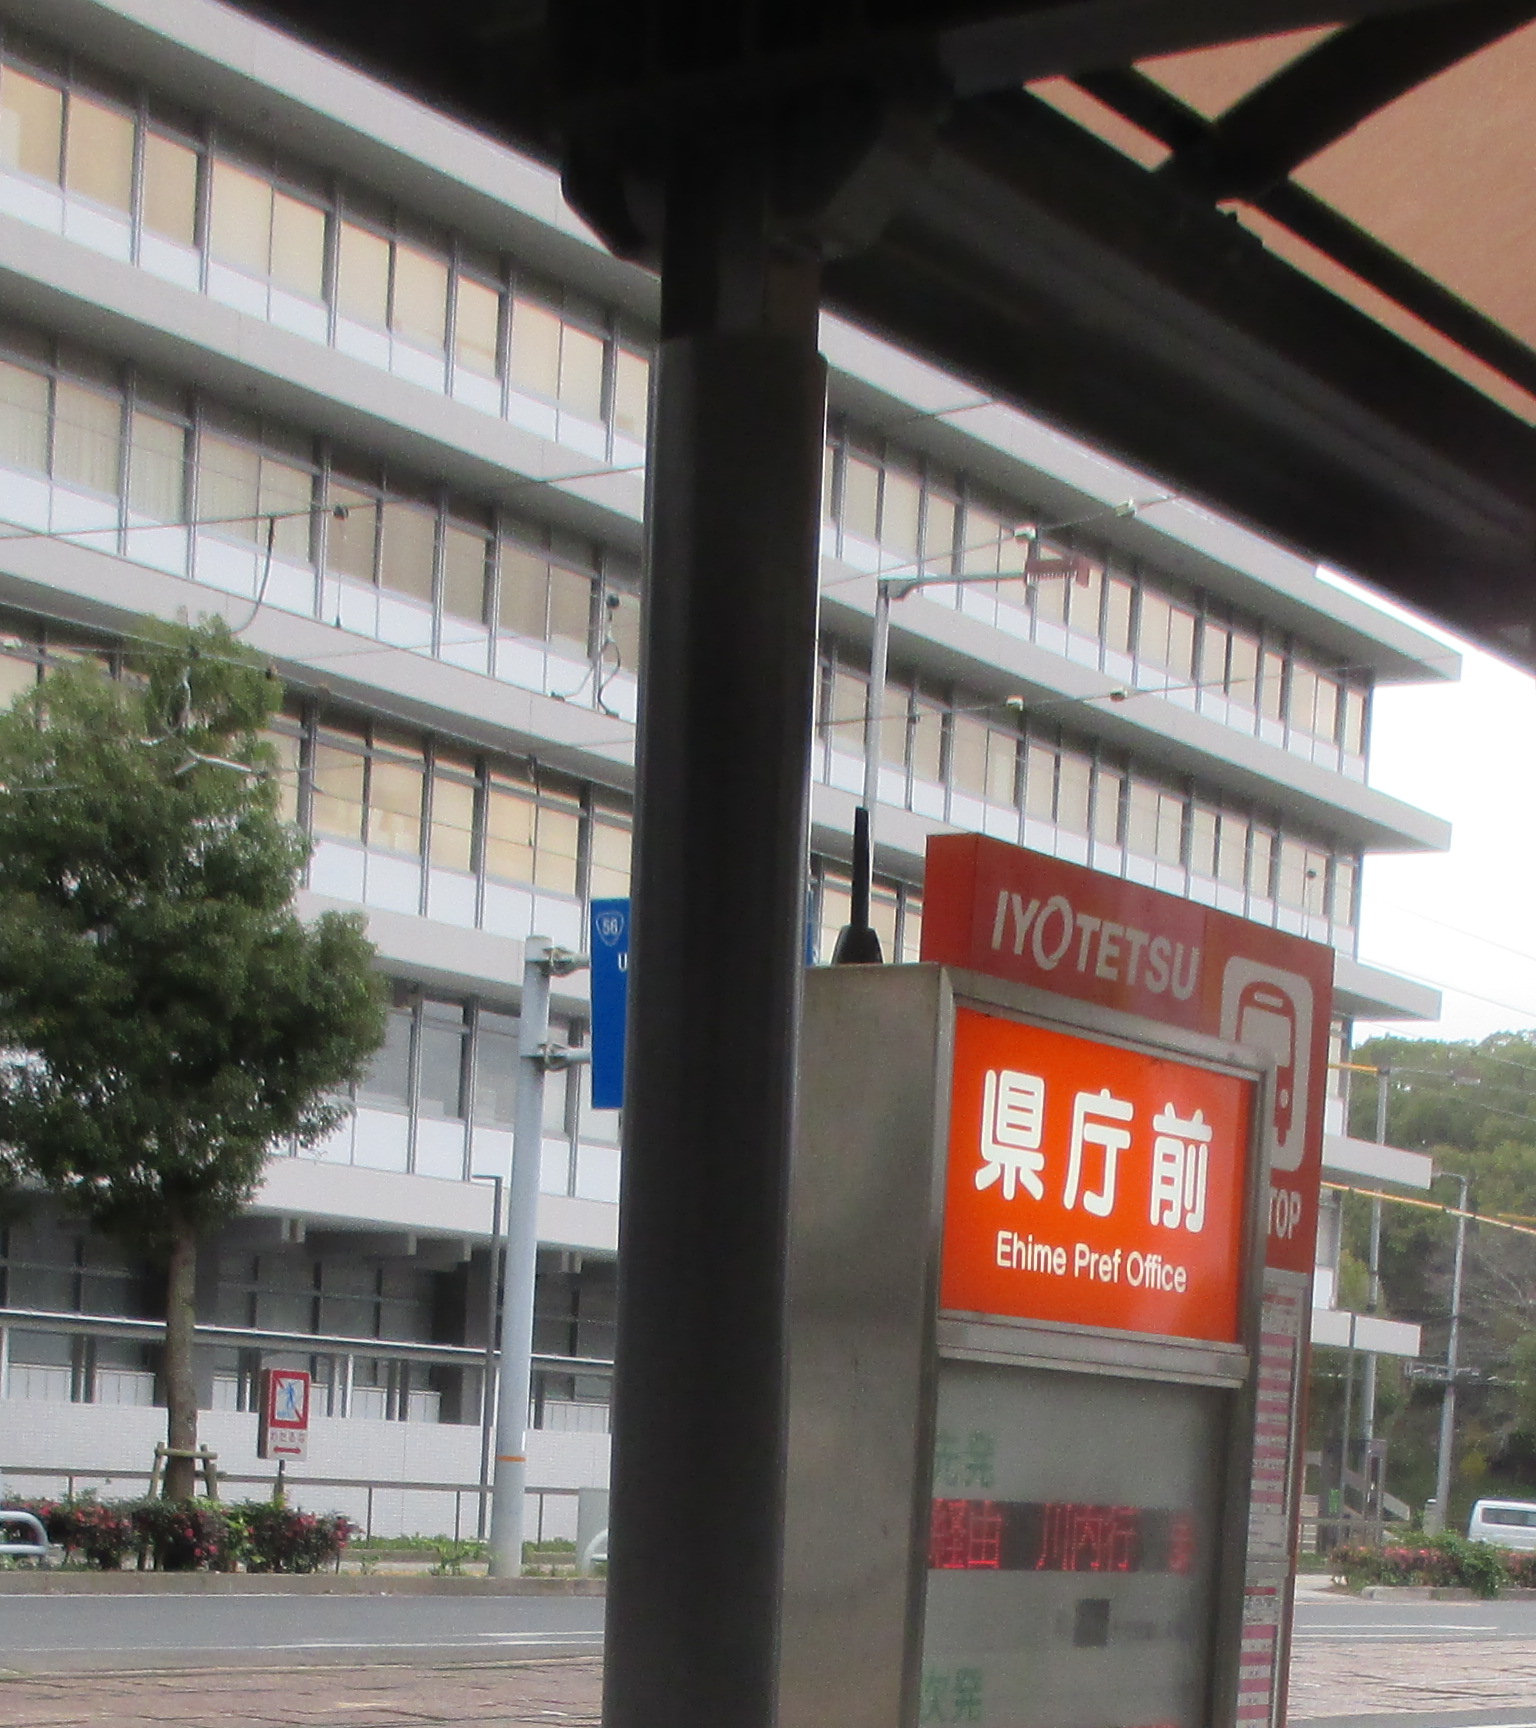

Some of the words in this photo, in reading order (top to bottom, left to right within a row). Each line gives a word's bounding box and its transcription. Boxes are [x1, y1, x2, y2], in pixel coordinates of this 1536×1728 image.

[992, 890, 1200, 999] IYOTETSU
[975, 1067, 1212, 1233] 県庁前
[997, 1230, 1067, 1276] Ehime
[1075, 1243, 1122, 1285] Pref
[1126, 1251, 1188, 1293] Office
